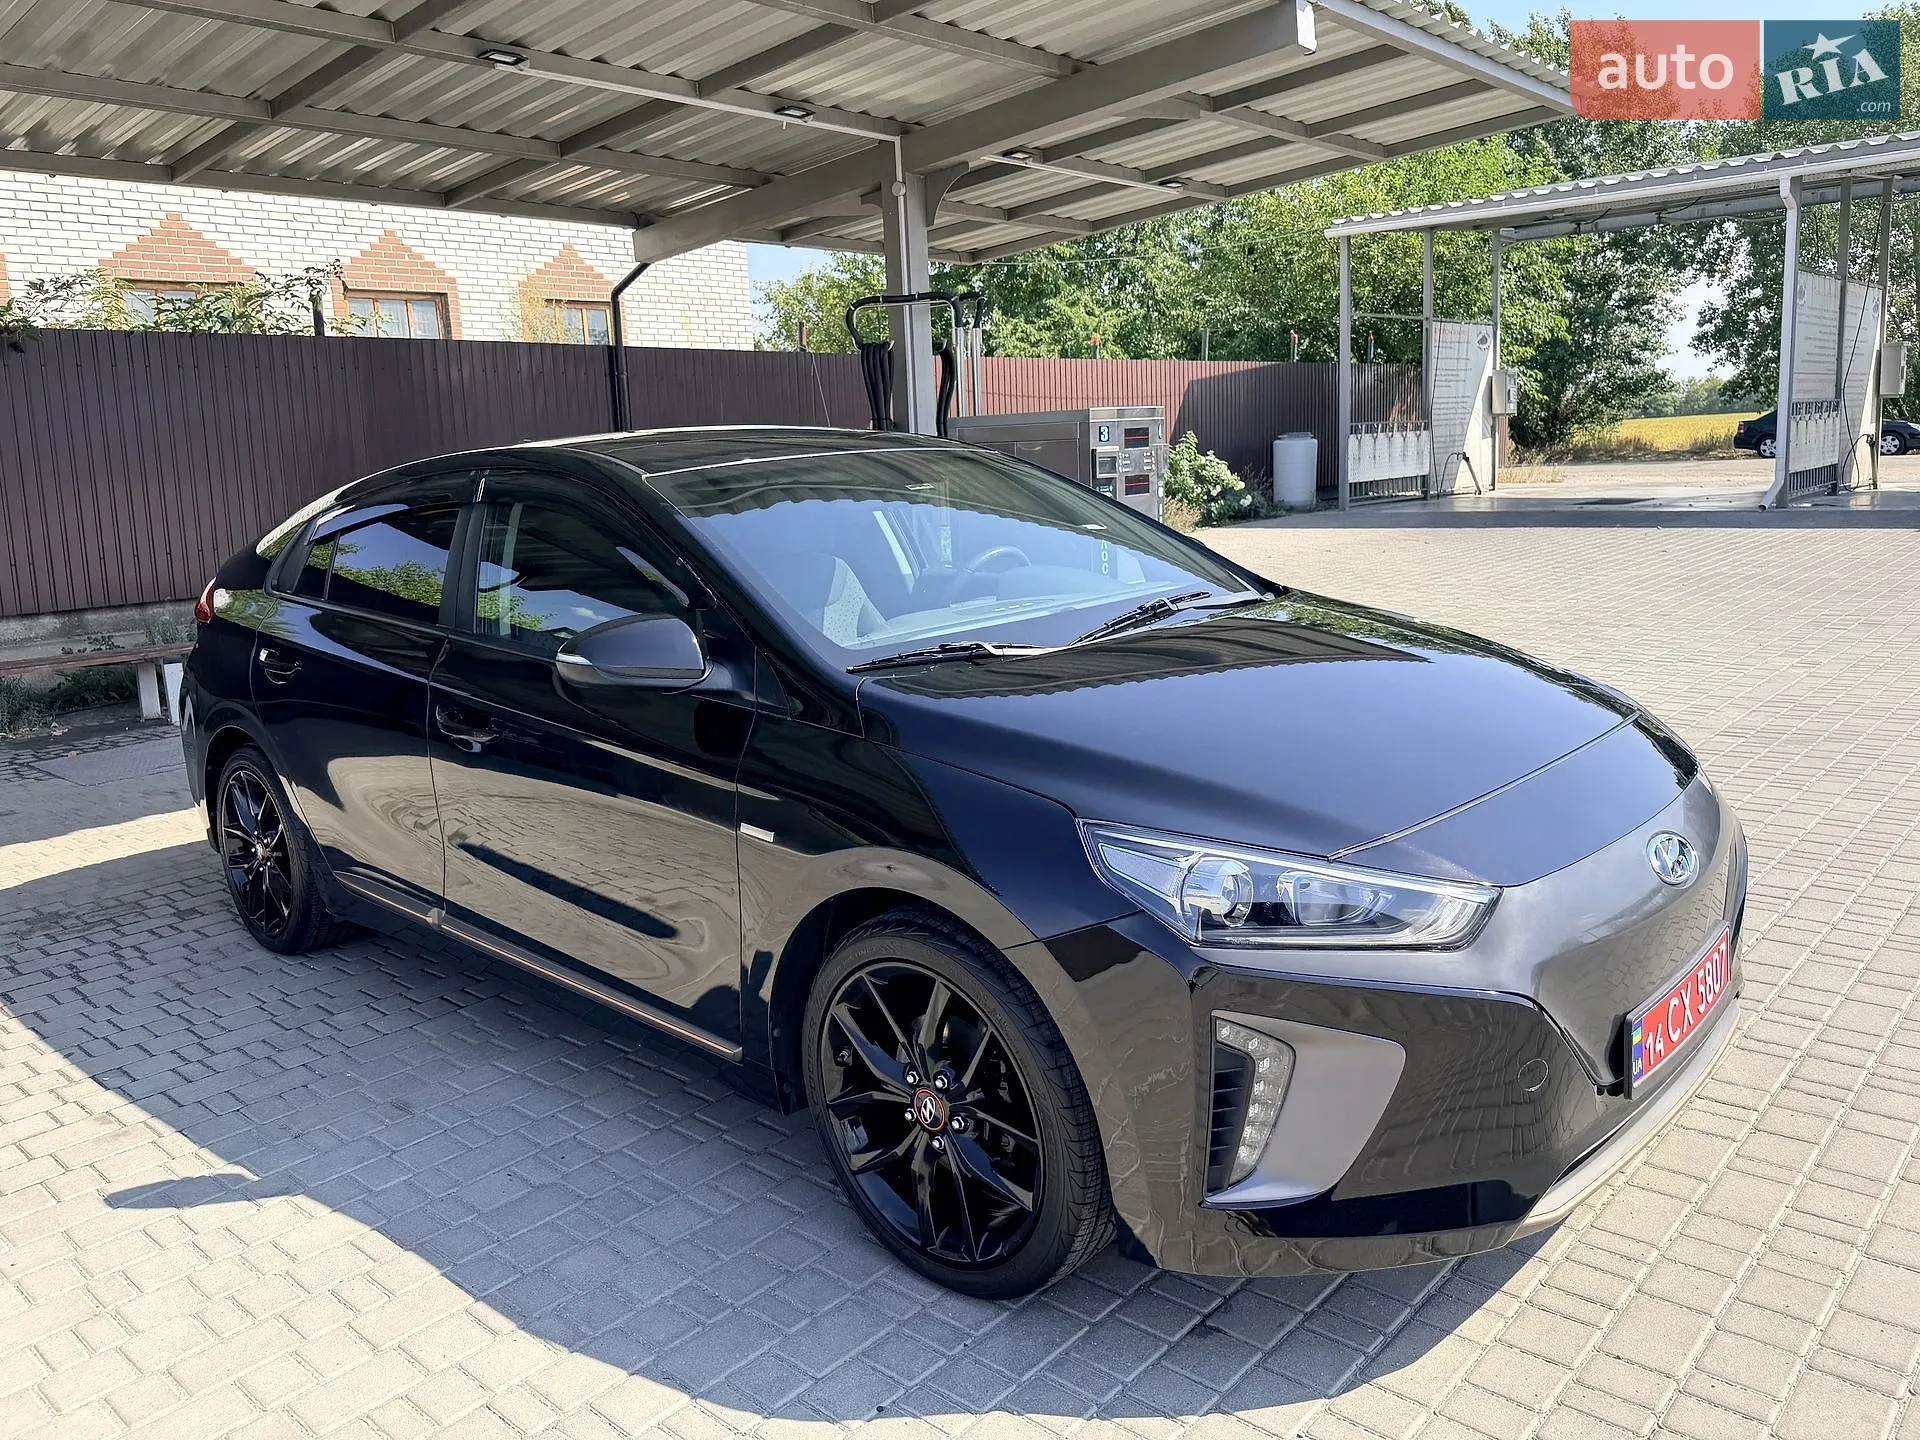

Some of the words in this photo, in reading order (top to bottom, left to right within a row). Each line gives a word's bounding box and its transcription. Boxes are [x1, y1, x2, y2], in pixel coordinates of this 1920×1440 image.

[1100, 426, 1109, 442] 3
[1645, 1023, 1665, 1066] 14
[1667, 981, 1694, 1043] CX
[1696, 941, 1727, 1014] 5807
[1632, 1060, 1643, 1076] UA
